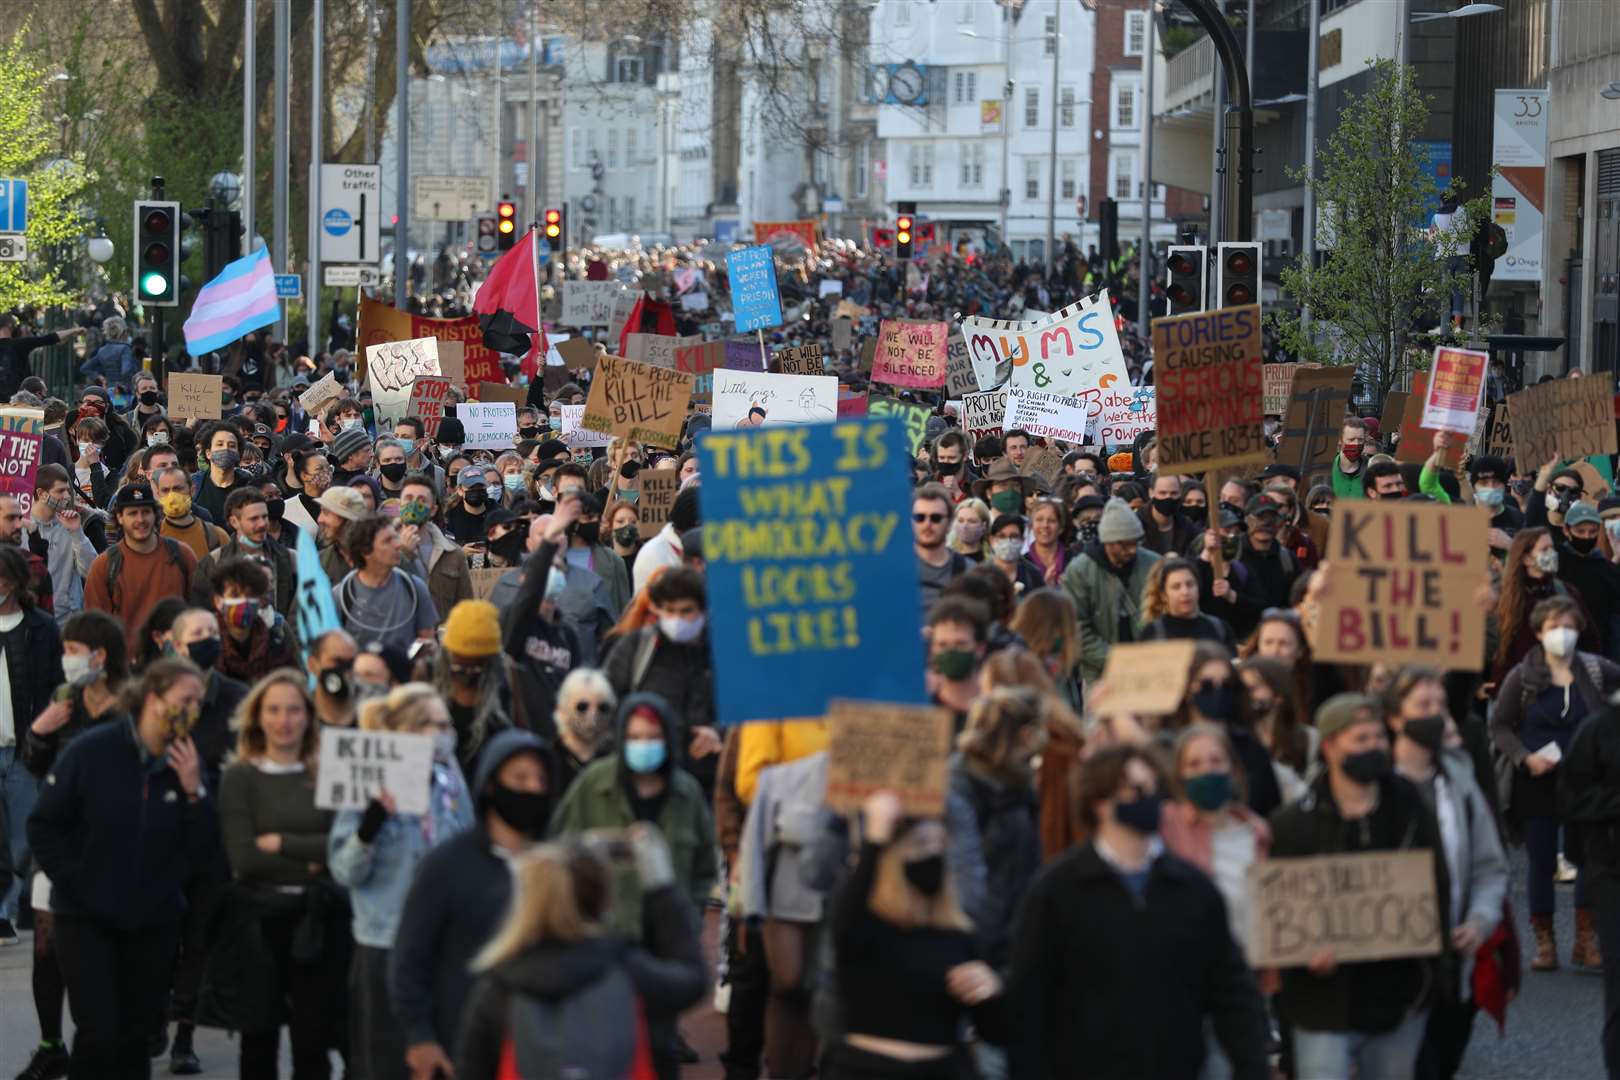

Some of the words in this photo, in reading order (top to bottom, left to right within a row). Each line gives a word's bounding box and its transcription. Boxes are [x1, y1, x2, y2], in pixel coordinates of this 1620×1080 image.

[1513, 96, 1542, 117] 33
[344, 168, 375, 178] Other
[342, 180, 377, 190] traffic
[740, 288, 775, 305] PRISON
[419, 325, 484, 340] BRISTO
[745, 315, 772, 330] VOTE
[1157, 309, 1253, 349] TORIES
[886, 331, 899, 343] WE
[908, 334, 935, 346] WILL
[971, 312, 1104, 367] MUMS
[781, 349, 793, 361] WE
[800, 345, 821, 359] WILL
[887, 346, 906, 358] NOT
[1166, 342, 1245, 370] CAUSING
[600, 359, 617, 374] WE
[623, 362, 645, 376] THE
[650, 367, 689, 385] PEOPLE
[783, 360, 801, 373] NOT
[883, 362, 935, 376] SILENCED
[1032, 362, 1052, 388] &
[180, 383, 214, 394] KILL
[1160, 357, 1262, 400] SERIOUS
[185, 394, 201, 402] THE
[413, 380, 450, 400] STOP
[604, 379, 645, 407] KILL
[645, 380, 672, 401] THE
[1010, 388, 1024, 398] NO
[1026, 390, 1051, 401] RIGHT
[1052, 394, 1061, 404] TO
[417, 401, 440, 416] THE
[469, 407, 480, 418] NO
[483, 406, 515, 418] PROTESTS
[614, 402, 672, 424] BILL
[964, 393, 1007, 414] PROTEC
[1040, 407, 1059, 415] KOREA
[1077, 388, 1132, 418] Babe
[1158, 389, 1264, 437] ANNOYANCE
[423, 416, 441, 437] OT
[969, 414, 988, 428] YOUR
[465, 435, 475, 445] NO
[478, 432, 513, 443] DEMOCRAC
[1020, 422, 1048, 435] UNITED
[1048, 427, 1082, 442] KINGDOM
[10, 435, 38, 460] THE
[703, 427, 812, 479] THIS
[834, 422, 887, 472] IS
[1159, 430, 1212, 464] SINCE
[1219, 423, 1262, 456] 1834
[643, 479, 673, 490] KILL
[645, 491, 671, 505] THE
[739, 476, 851, 517] WHAT
[703, 512, 899, 562] DEMOCRACY
[1341, 512, 1467, 564] KILL
[740, 561, 857, 609] LOOKS
[1357, 566, 1441, 608] THE
[748, 606, 861, 656] LIKE!
[1336, 607, 1462, 654] BILL!
[337, 738, 403, 762] KILL
[350, 764, 384, 781] THE
[331, 782, 371, 804] BIL
[1258, 867, 1328, 899] THIS
